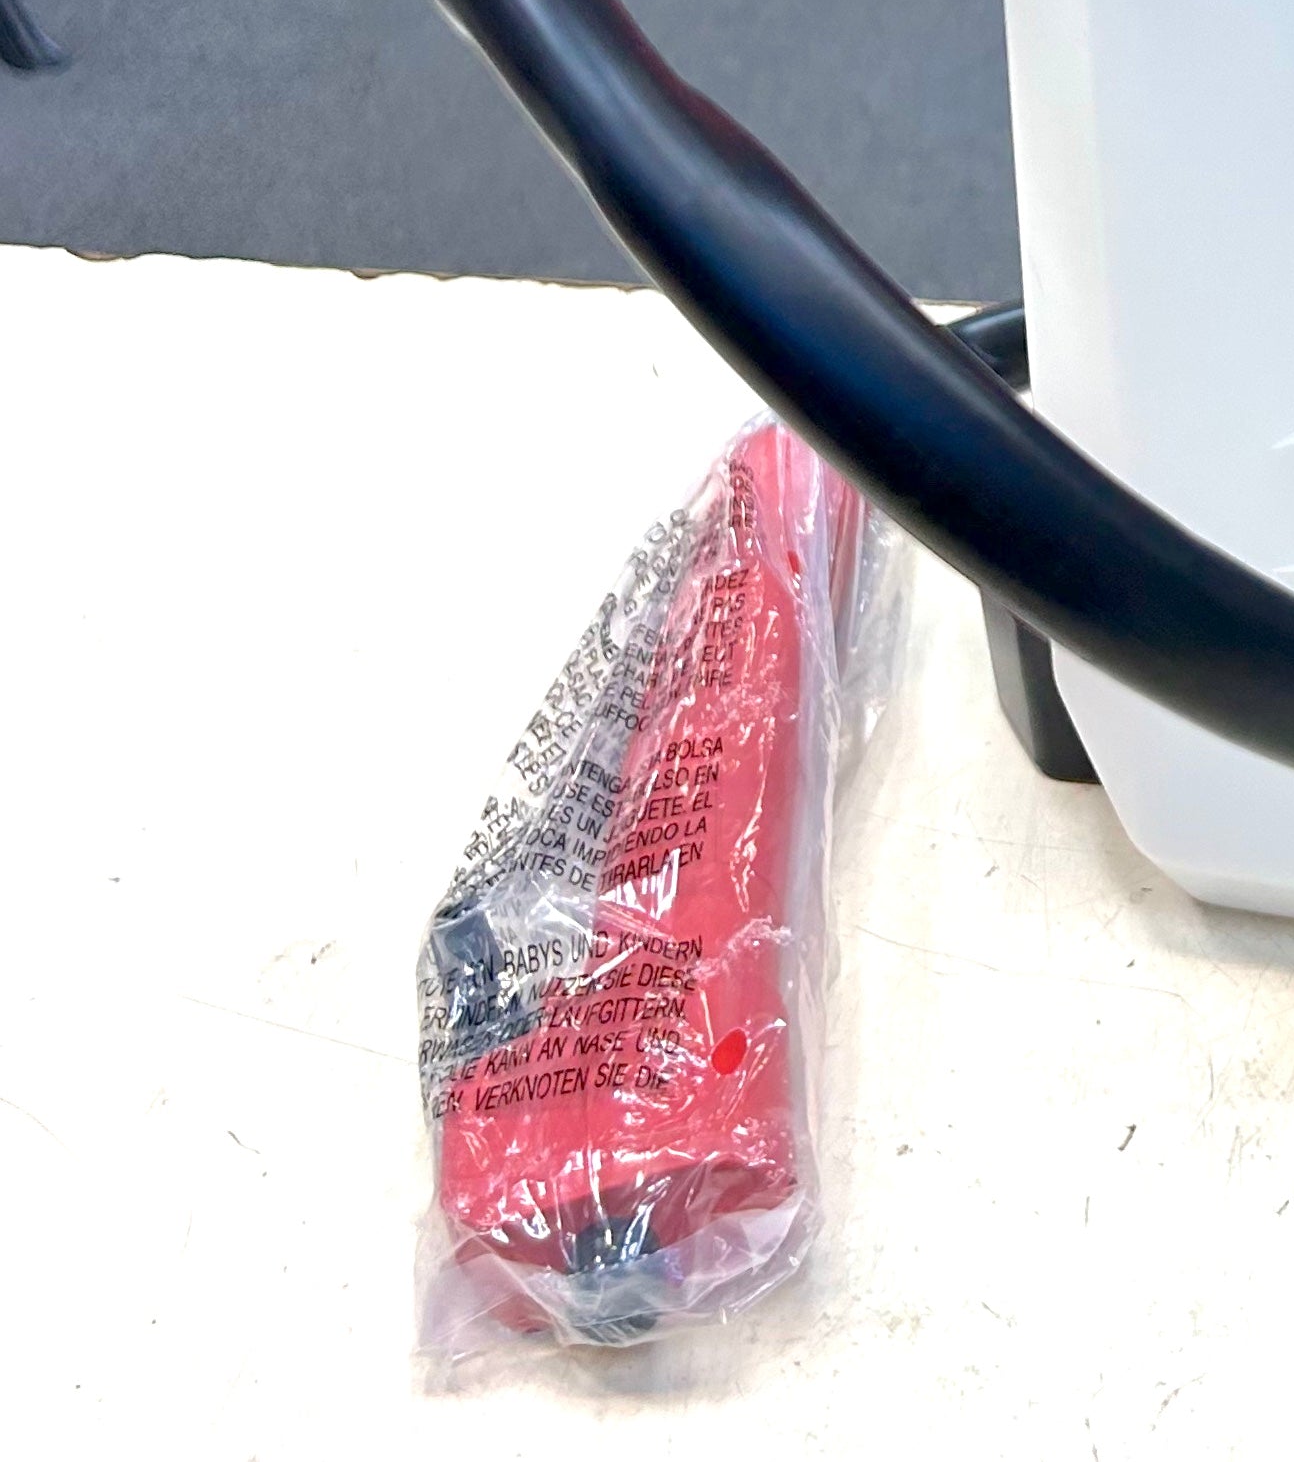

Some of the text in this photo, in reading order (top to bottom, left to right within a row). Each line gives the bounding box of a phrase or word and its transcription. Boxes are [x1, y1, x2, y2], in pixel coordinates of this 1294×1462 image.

[665, 736, 724, 762] BOLSA
[694, 762, 719, 786] EN
[577, 812, 602, 841] UN
[692, 790, 713, 812] EL
[684, 816, 707, 837] LA
[569, 864, 596, 893] DE
[680, 840, 704, 867] EN
[503, 937, 563, 976] BABYS
[571, 930, 609, 963] UND
[619, 931, 703, 962] KINDERN
[603, 963, 636, 991] SIE
[637, 962, 697, 992] DIESE
[485, 1040, 535, 1076] KANN
[537, 1034, 567, 1062] AN
[573, 1029, 630, 1057] NASE
[475, 1064, 590, 1112] VERKNOTEN
[595, 1062, 628, 1089] SIE
